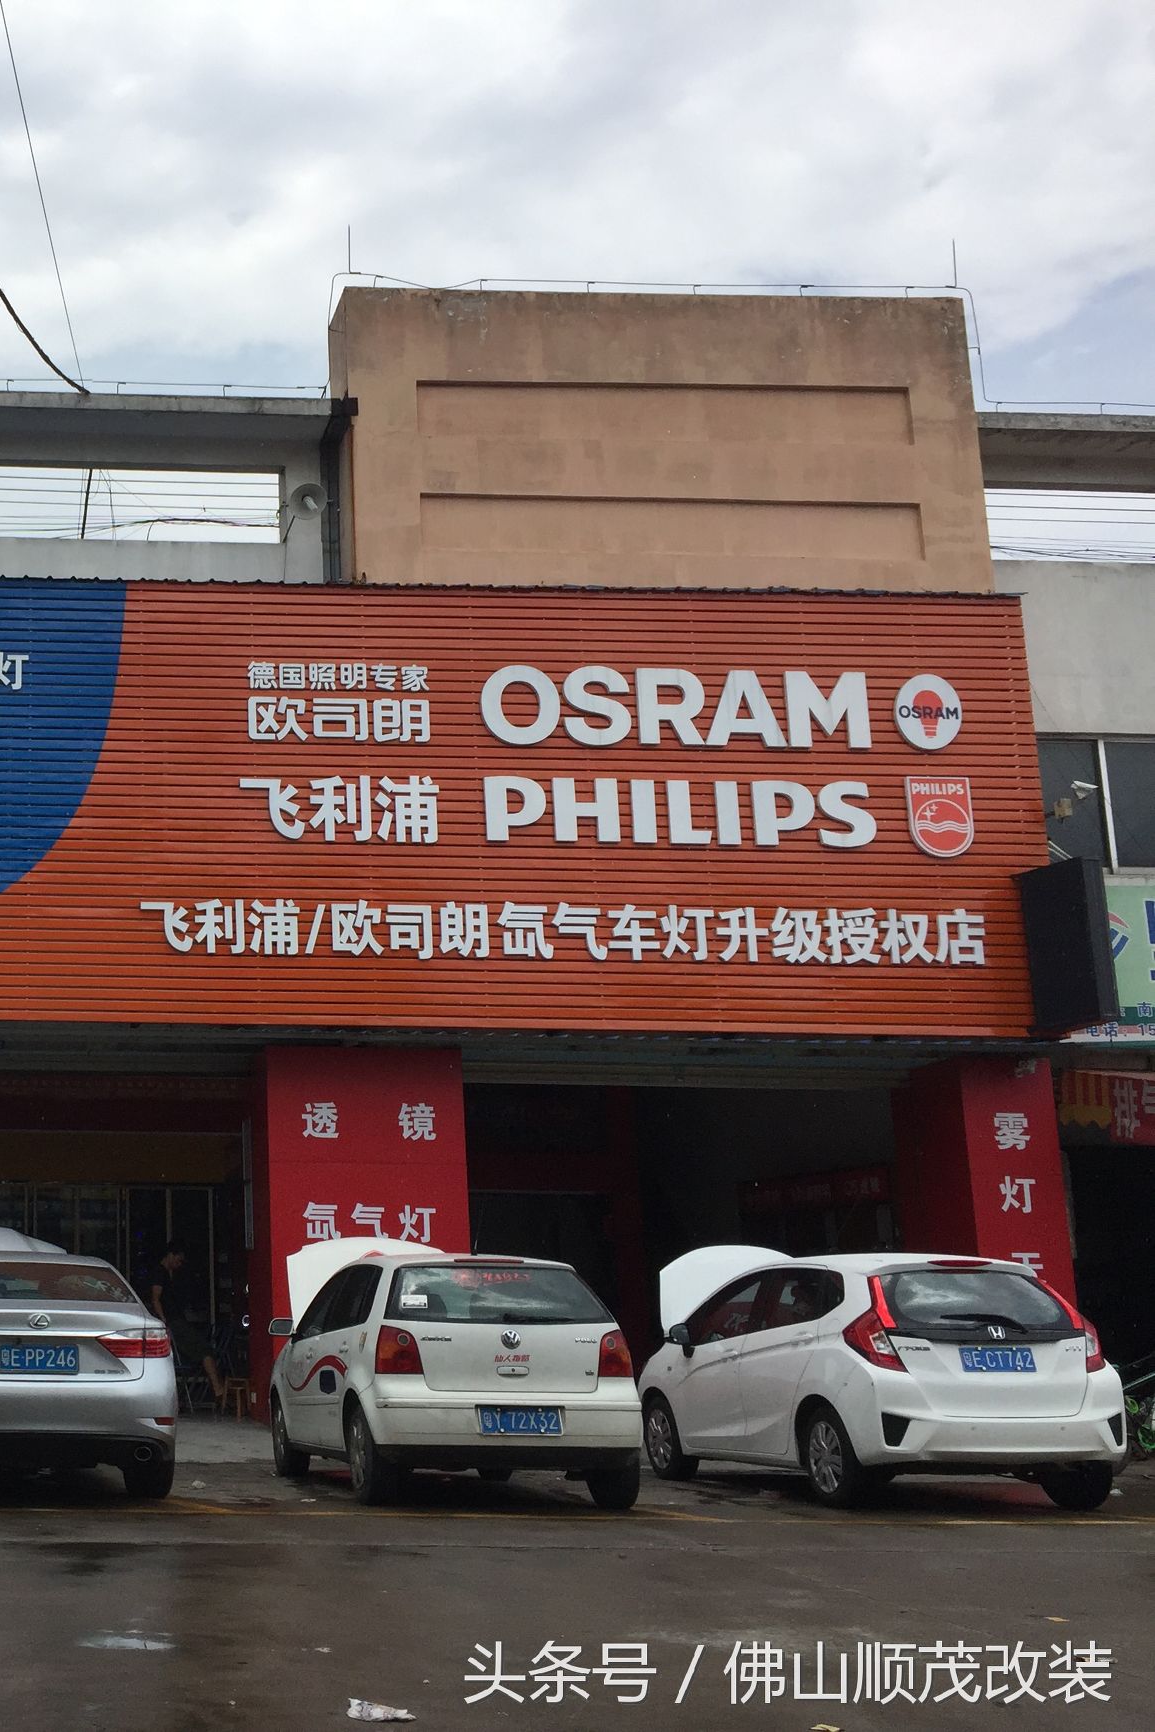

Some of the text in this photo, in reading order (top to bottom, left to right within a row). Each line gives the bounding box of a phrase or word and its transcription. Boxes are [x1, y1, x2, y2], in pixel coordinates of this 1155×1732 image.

[247, 661, 431, 692] 德国照明专家
[248, 696, 431, 743] 欧司朗
[481, 664, 872, 750] OSRAM
[899, 703, 959, 721] OSRAM
[239, 775, 440, 844] 飞利浦
[911, 782, 965, 796] PHILIPS
[483, 775, 877, 850] PHILIPS
[140, 899, 986, 966] 飞利浦/欧司朗氙气车灯升级授权店
[302, 1102, 437, 1141] 透镜
[302, 1202, 436, 1243] 氙气灯
